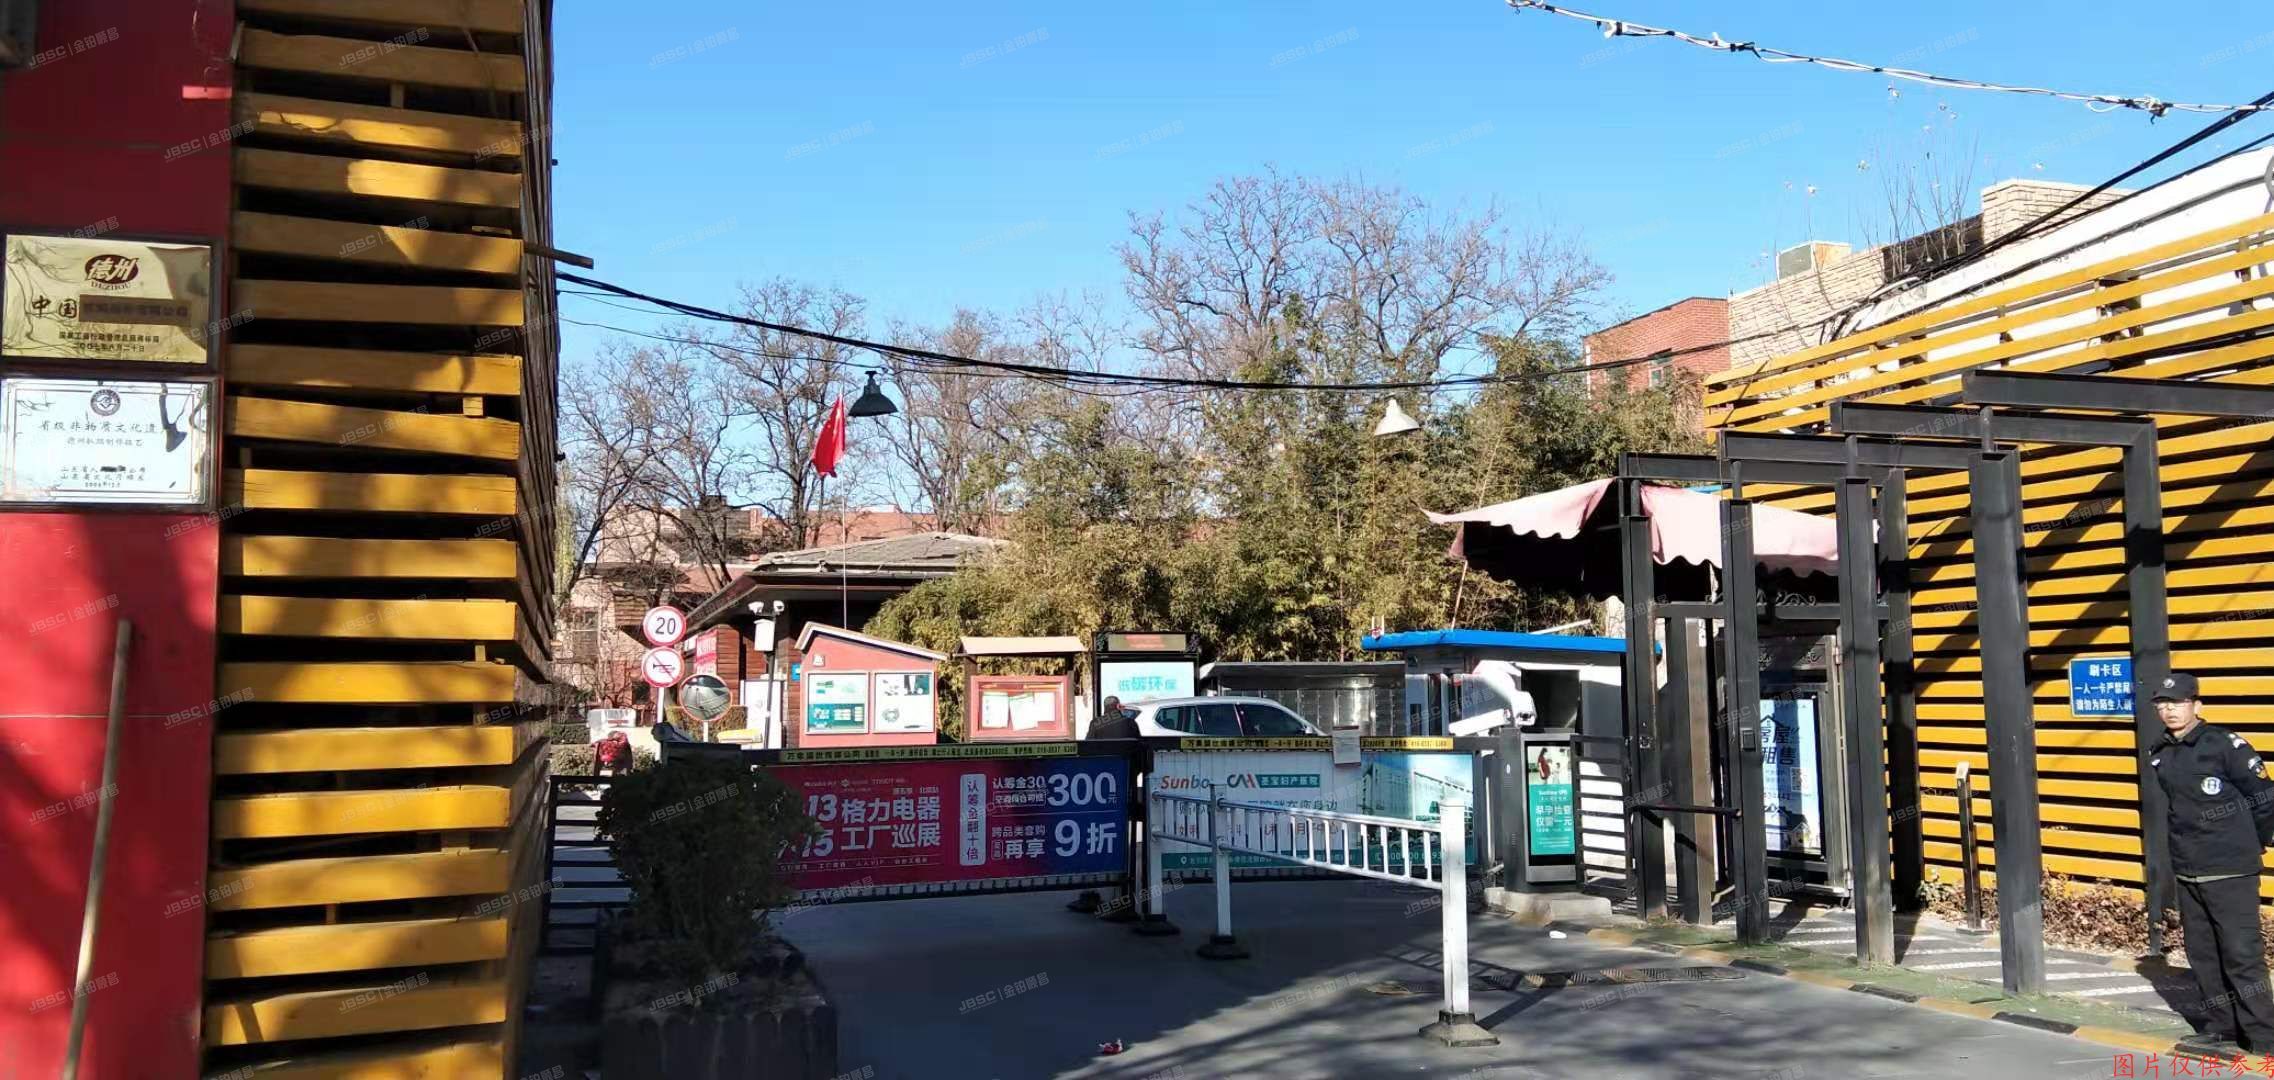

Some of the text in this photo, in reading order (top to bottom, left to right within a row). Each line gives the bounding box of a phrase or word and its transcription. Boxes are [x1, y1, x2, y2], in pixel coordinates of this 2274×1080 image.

[88, 257, 138, 281] 德州
[32, 295, 78, 319] 中国
[38, 420, 160, 434] 省级非物质文化遗
[655, 617, 676, 635] 20
[2089, 664, 2123, 677] 刷卡区
[2074, 682, 2132, 694] 一人一卡严禁尾
[2075, 698, 2133, 711] 请勿为陌生人刷
[1161, 774, 1211, 789] Sunbo
[842, 796, 941, 824] 格力电器
[841, 822, 941, 851] 工厂巡展
[1054, 819, 1117, 857] 9折
[1005, 838, 1046, 859] 再享
